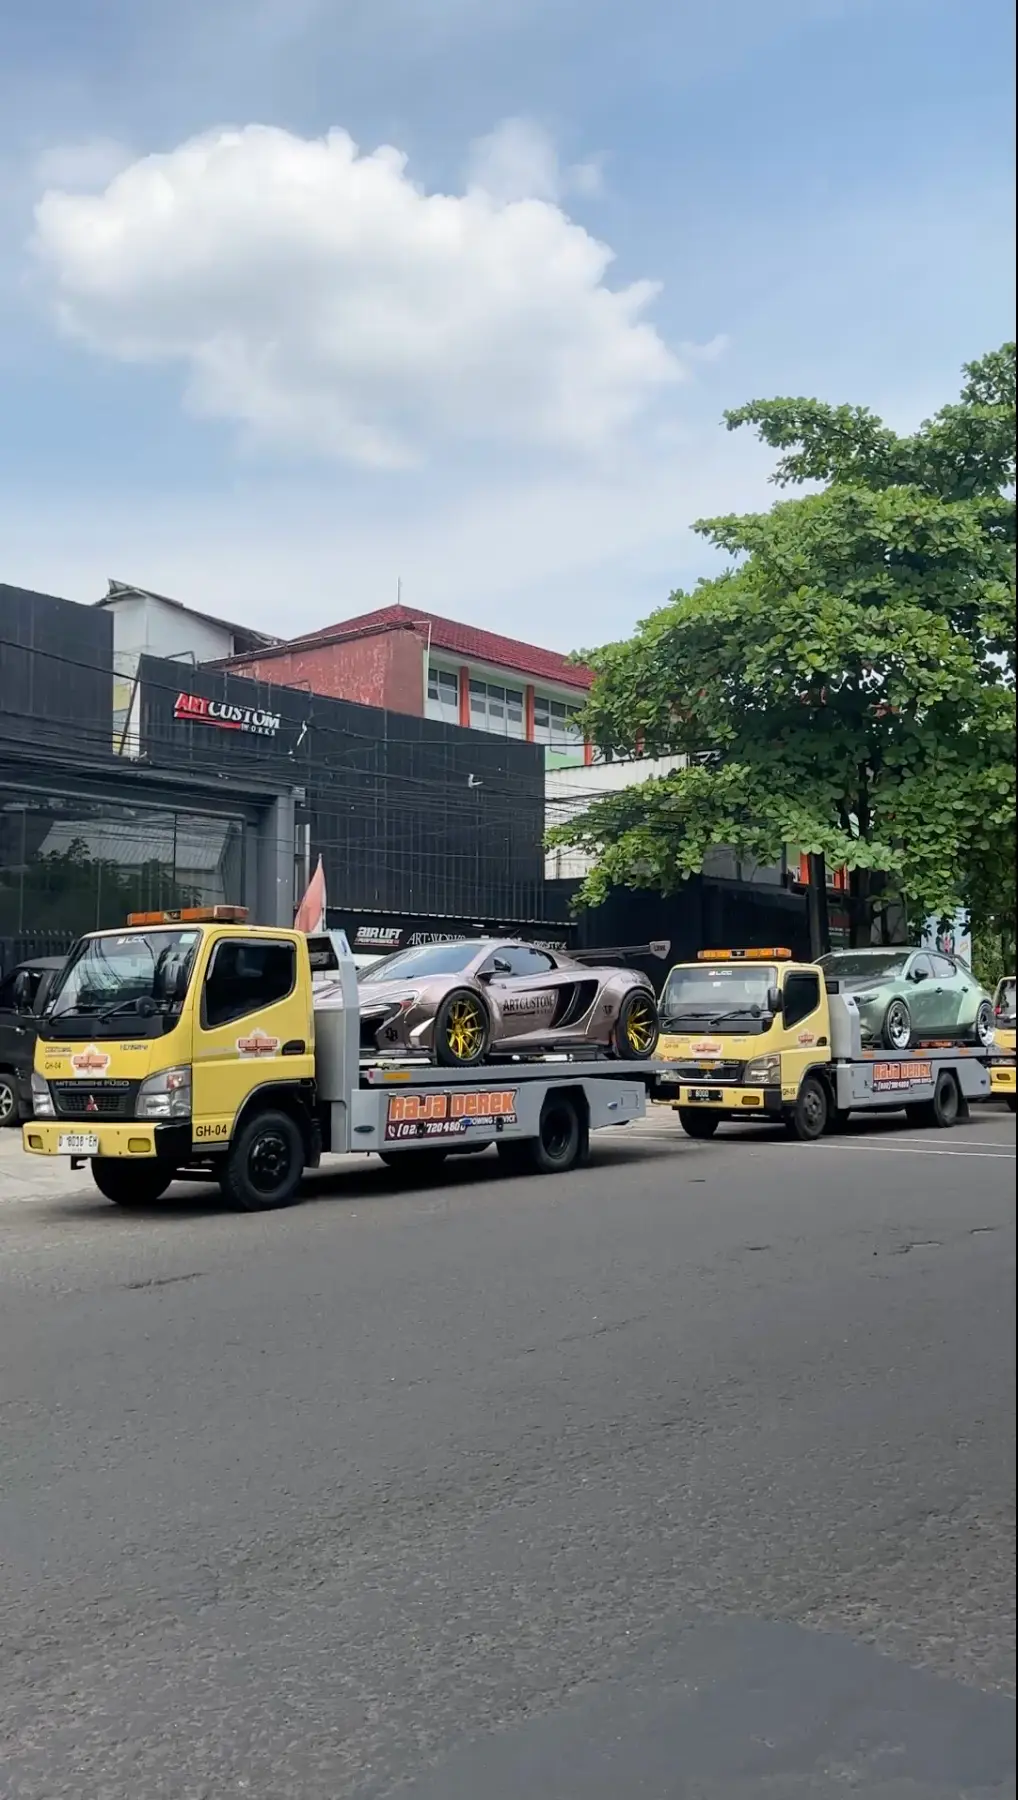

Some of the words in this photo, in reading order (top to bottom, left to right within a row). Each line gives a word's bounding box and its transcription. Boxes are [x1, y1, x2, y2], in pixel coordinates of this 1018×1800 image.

[241, 723, 276, 737] WORKS
[471, 1115, 493, 1126] OWING
[494, 1114, 516, 1124] SVICE
[196, 1125, 227, 1137] GH-04
